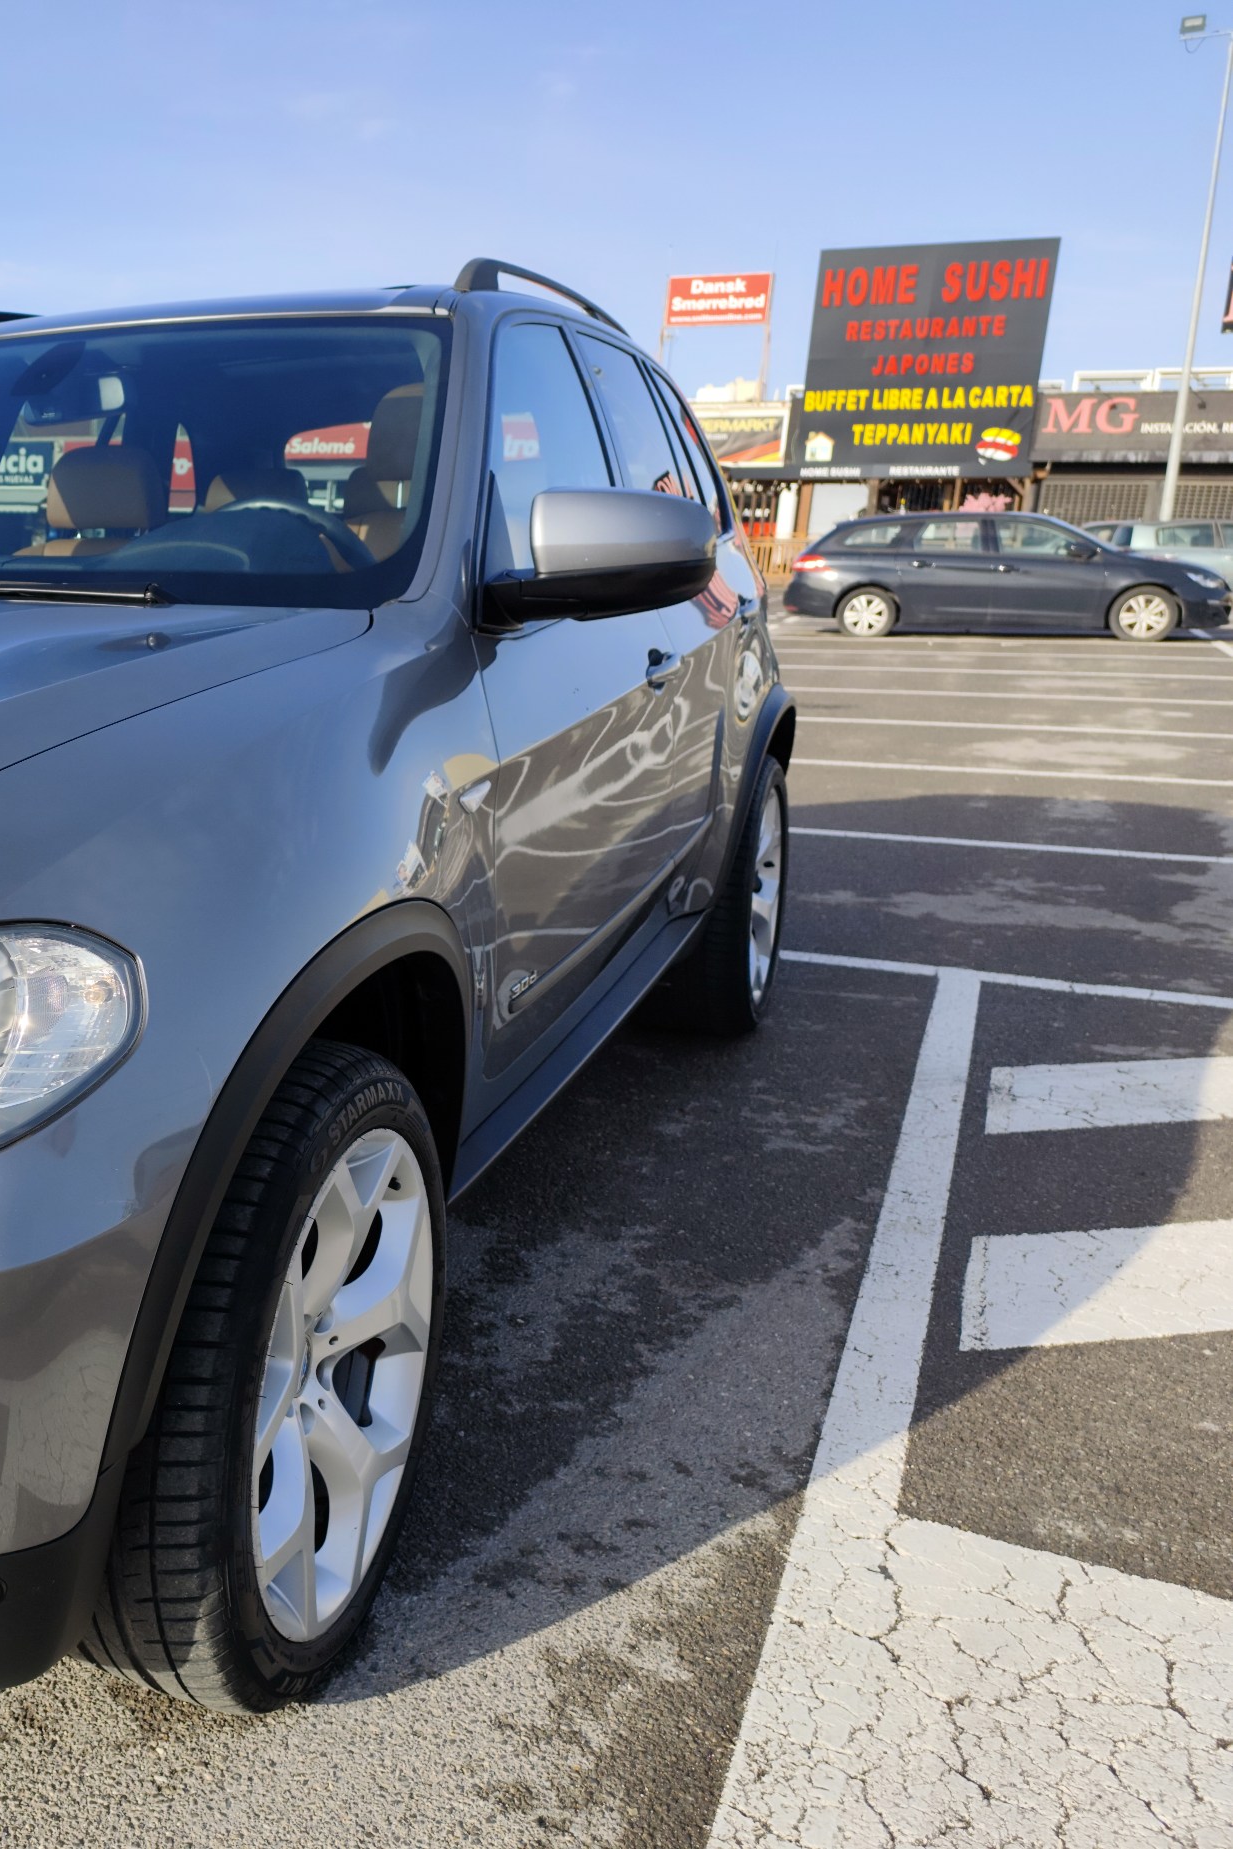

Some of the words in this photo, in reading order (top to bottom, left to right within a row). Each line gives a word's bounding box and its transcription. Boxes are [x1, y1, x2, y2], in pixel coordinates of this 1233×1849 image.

[690, 278, 747, 295] Dansk
[821, 264, 920, 308] HOME
[941, 258, 1050, 303] SUSHI
[845, 315, 1007, 342] RESTAURANTE
[871, 352, 974, 376] JAPONES
[804, 389, 869, 412] BUFFET
[872, 387, 924, 410] LIBRE
[925, 387, 939, 410] A
[941, 386, 966, 409] LA
[968, 384, 1034, 408] CARTA
[1041, 396, 1139, 433] MG
[290, 436, 355, 454] Salomé
[852, 422, 973, 445] TEPPANYAKI
[800, 467, 829, 477] HOME
[830, 467, 861, 477] SUSHI
[889, 465, 960, 477] RESTAURANTE
[328, 1081, 404, 1146] STARMAXX
